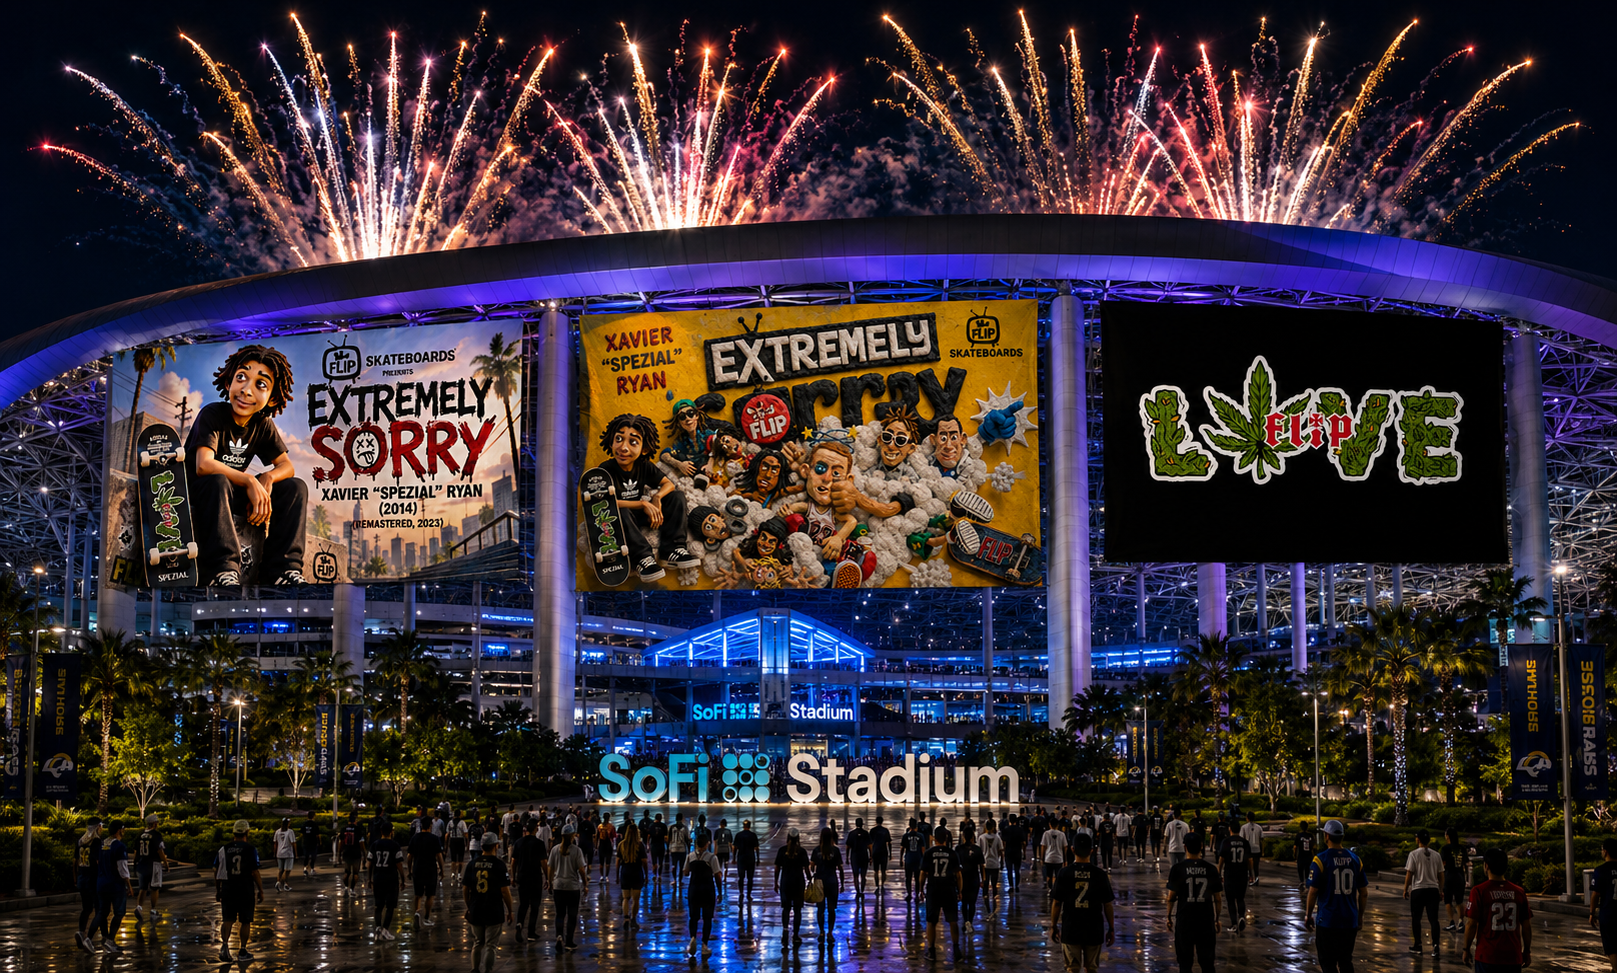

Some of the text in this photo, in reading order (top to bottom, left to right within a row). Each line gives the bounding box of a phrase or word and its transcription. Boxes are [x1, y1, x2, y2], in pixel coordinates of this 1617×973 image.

[604, 326, 673, 352] XAVIER
[972, 328, 995, 340] FLIP
[366, 350, 455, 367] SKATEBOARDS
[710, 319, 932, 385] EXTREMELY
[950, 348, 1023, 358] SKATEBOARDS
[329, 360, 356, 374] FLIP
[617, 370, 666, 396] RYAN
[308, 377, 493, 429] EXTREMELY
[749, 416, 787, 440] FLIP
[311, 415, 497, 484] SORRY
[321, 488, 368, 501] XAVIER
[447, 484, 482, 498] RYAN
[379, 502, 417, 516] (2014)
[417, 518, 443, 529] 2023)
[977, 536, 1014, 566] FLIP
[693, 703, 853, 720] SoFi Stadium
[598, 753, 1019, 804] SoFi Stadium
[1074, 881, 1090, 908] 2
[1185, 877, 1208, 903] 17
[1332, 868, 1355, 895] 10
[1491, 902, 1517, 931] 23
